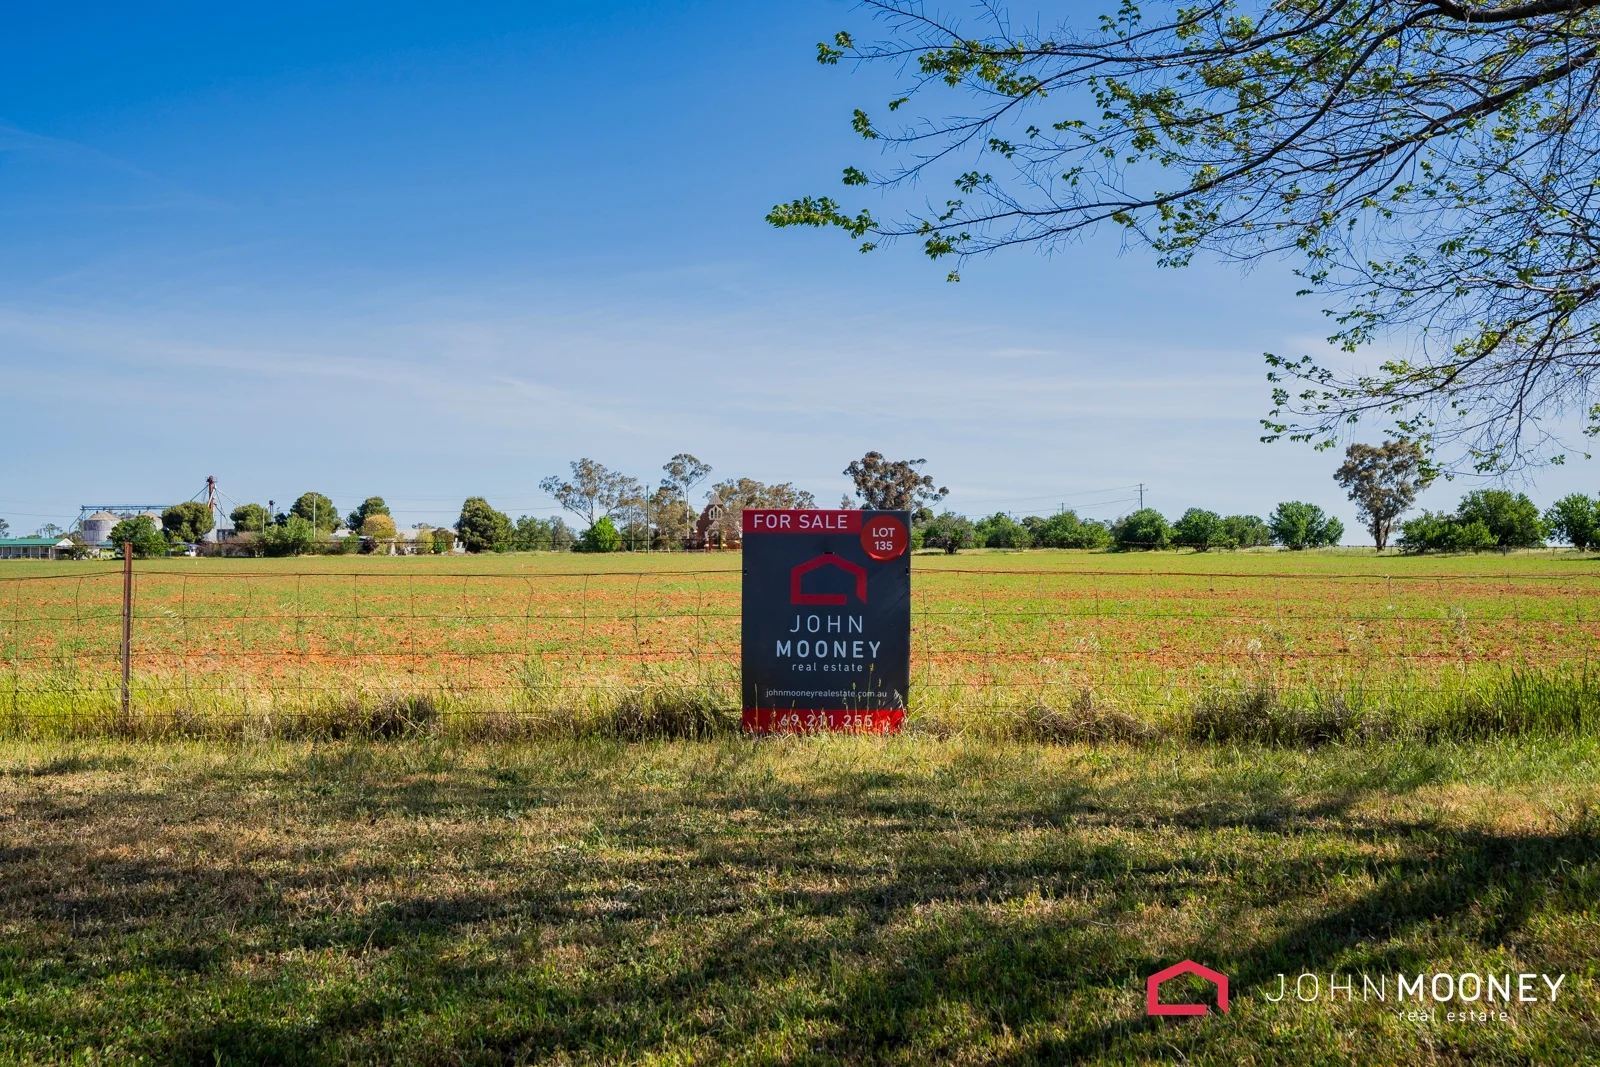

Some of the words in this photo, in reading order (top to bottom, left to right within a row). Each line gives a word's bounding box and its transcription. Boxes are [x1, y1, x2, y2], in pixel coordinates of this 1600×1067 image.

[753, 514, 791, 529] FOR
[799, 514, 848, 529] SALE
[872, 527, 895, 538] LOT
[874, 541, 893, 550] 135
[789, 615, 863, 633] JOHN
[776, 640, 881, 658] MOONEY
[792, 662, 817, 672] real
[823, 662, 863, 672] estate
[766, 688, 887, 698] johnmooneyrealestate.com.au
[780, 714, 799, 727] 69
[806, 714, 834, 727] 211
[844, 714, 873, 728] 255
